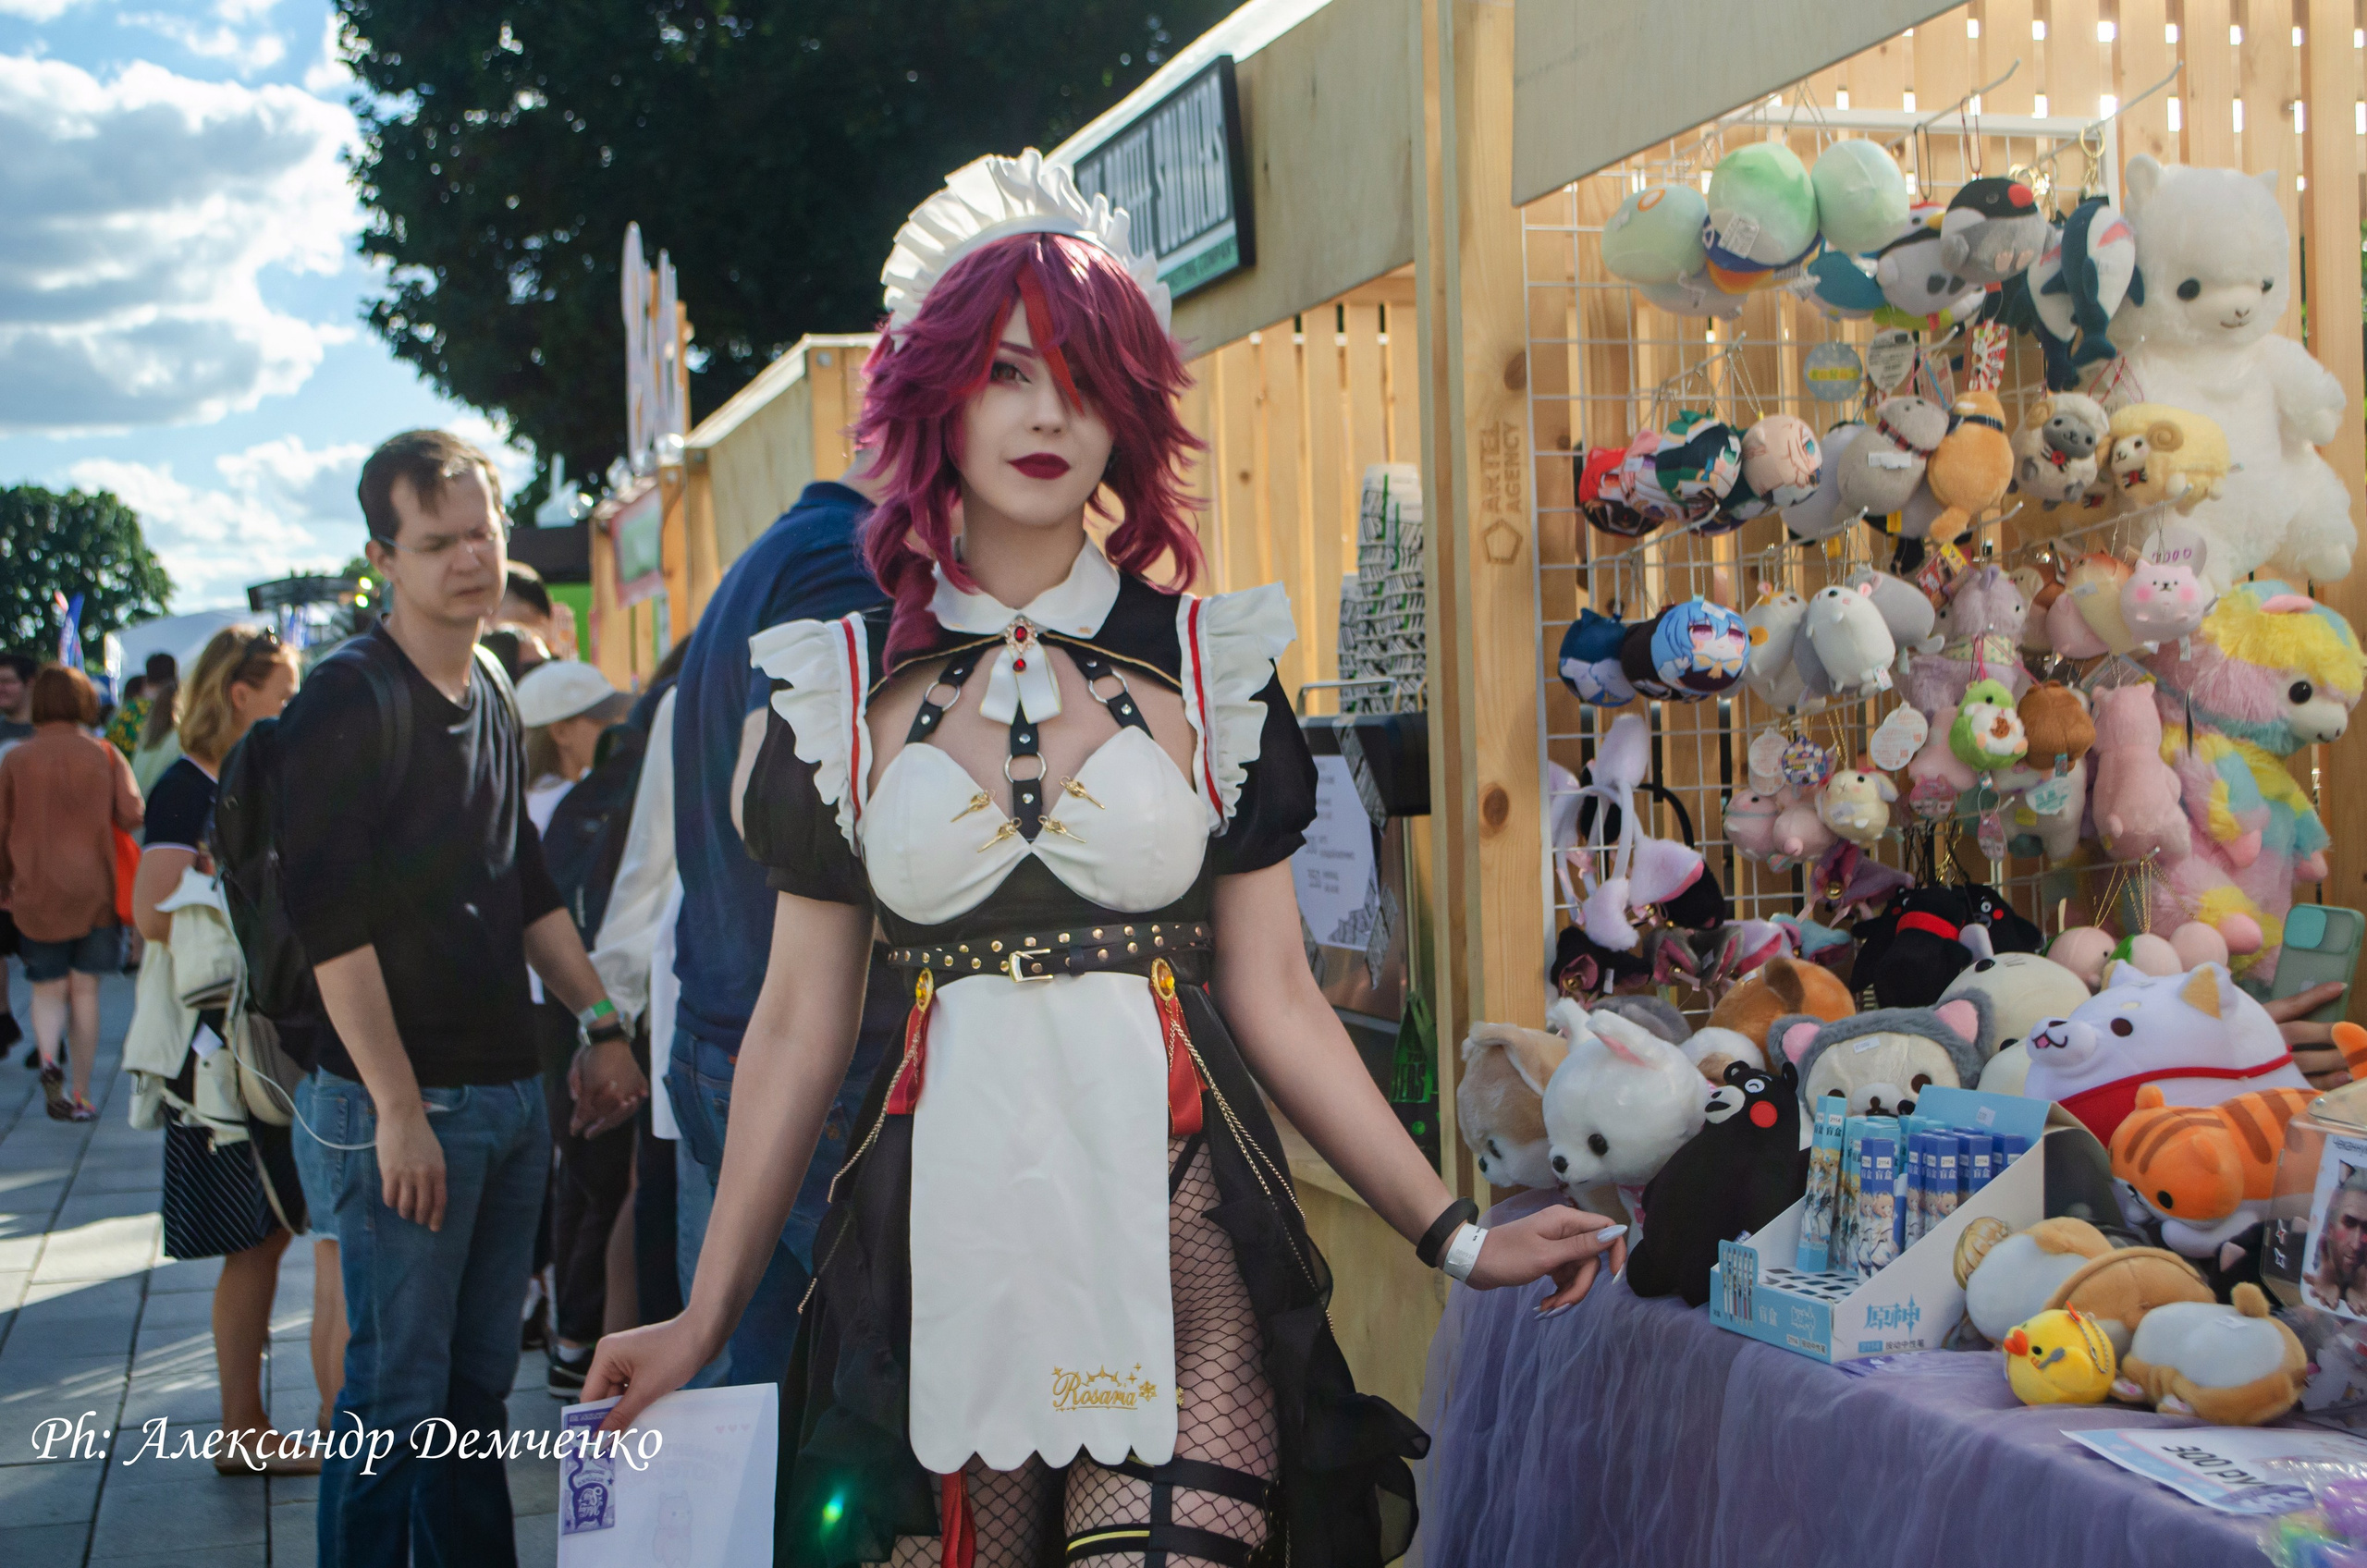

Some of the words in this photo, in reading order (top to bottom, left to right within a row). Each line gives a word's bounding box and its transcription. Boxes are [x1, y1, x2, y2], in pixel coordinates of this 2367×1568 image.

[1502, 422, 1522, 514] AGENCY
[1863, 1293, 1920, 1340] 原神
[2160, 1445, 2233, 1467] 300
[2202, 1468, 2267, 1486] РУ
